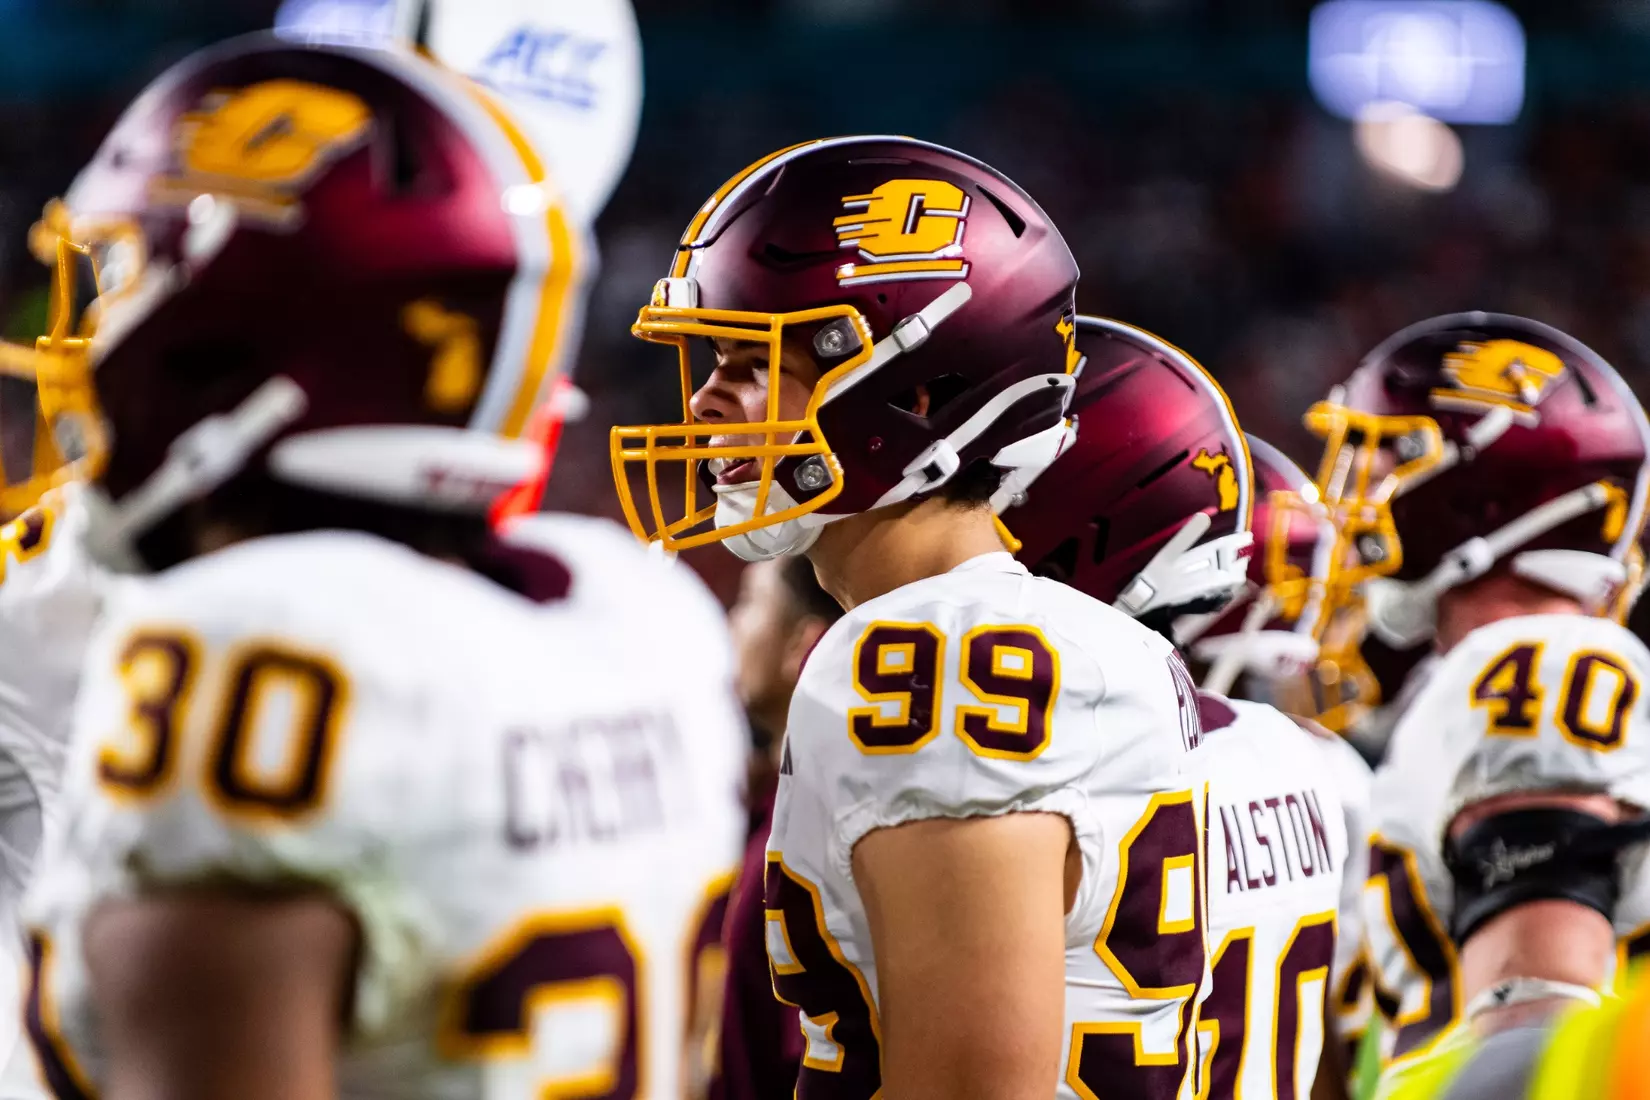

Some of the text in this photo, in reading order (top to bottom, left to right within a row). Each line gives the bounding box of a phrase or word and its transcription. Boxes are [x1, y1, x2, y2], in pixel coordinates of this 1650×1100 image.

[832, 178, 972, 266] C
[97, 625, 350, 822] 30
[848, 620, 1060, 761] 99
[1471, 640, 1639, 751] 40
[1219, 788, 1333, 894] ALSTON
